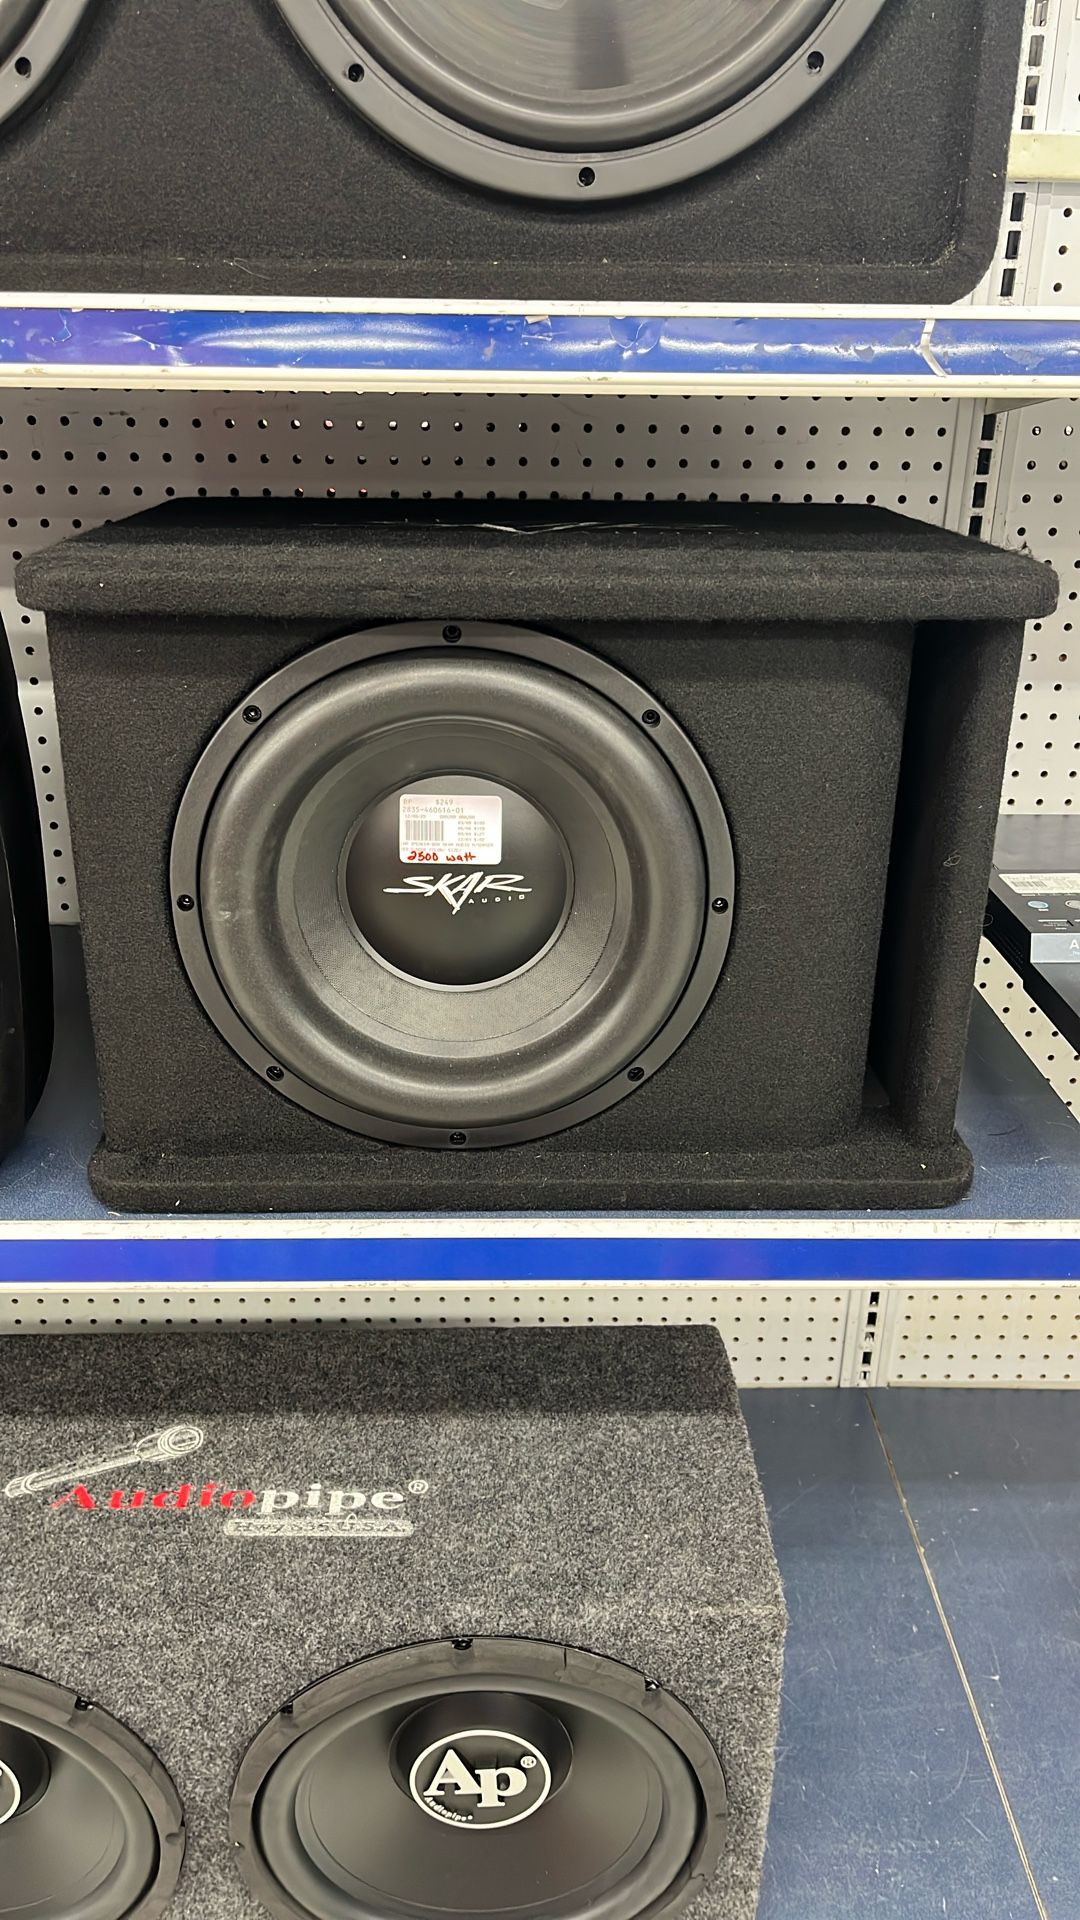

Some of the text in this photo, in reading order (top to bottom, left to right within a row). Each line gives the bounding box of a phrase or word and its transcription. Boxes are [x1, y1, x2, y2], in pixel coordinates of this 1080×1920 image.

[407, 850, 477, 862] 2500 watt
[382, 871, 533, 915] SKAR
[467, 893, 526, 905] AUDIO
